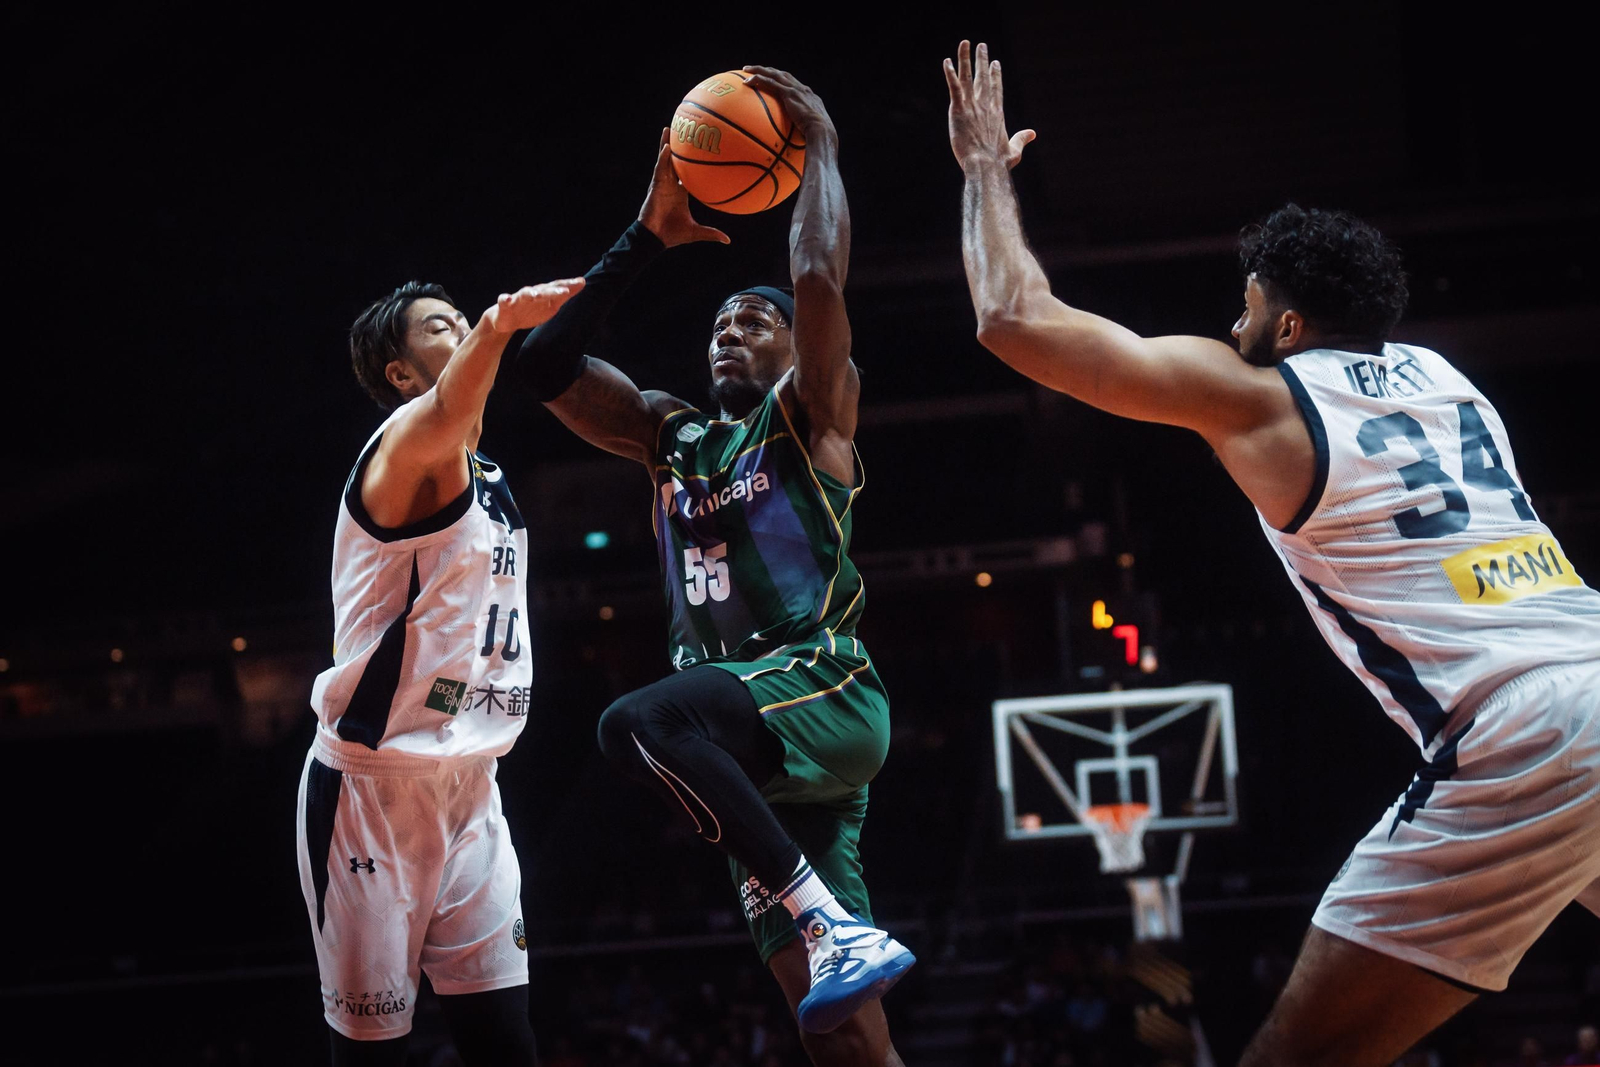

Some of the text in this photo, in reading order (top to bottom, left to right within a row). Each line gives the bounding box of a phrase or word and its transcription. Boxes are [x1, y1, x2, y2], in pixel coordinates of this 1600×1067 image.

[1356, 400, 1538, 540] 34
[683, 542, 731, 606] 55
[1471, 542, 1564, 599] MANI
[480, 603, 521, 662] 10
[744, 894, 761, 910] DEL
[345, 990, 395, 1002] ニチガス
[345, 997, 406, 1017] NICIGAS
